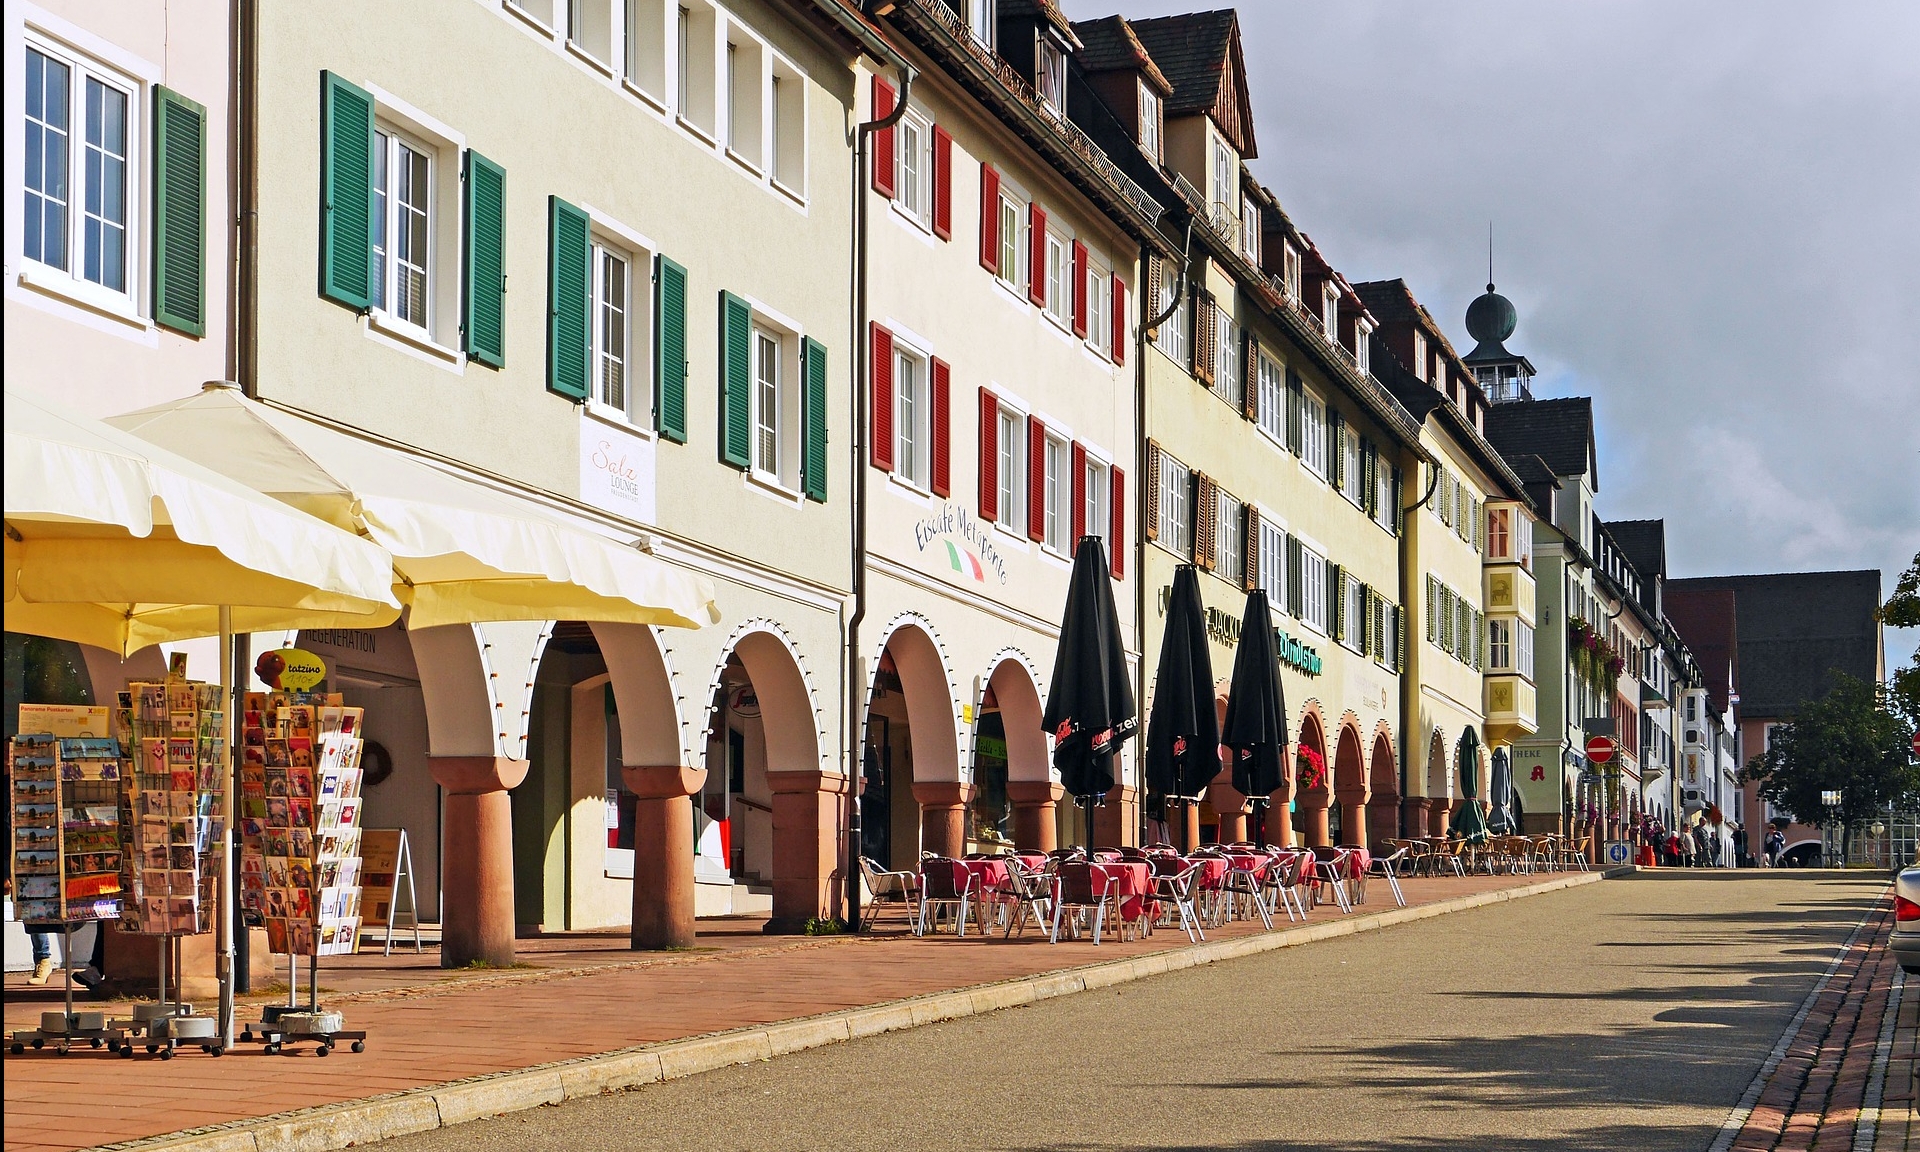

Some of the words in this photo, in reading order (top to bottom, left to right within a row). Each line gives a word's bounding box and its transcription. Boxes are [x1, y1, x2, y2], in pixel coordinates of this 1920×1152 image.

[592, 440, 637, 481] Salz
[610, 475, 639, 496] LOUNGE
[915, 502, 953, 552] Eiscafé
[957, 505, 1007, 586] Metaponto
[305, 628, 376, 654] REGENERATION
[288, 663, 321, 674] tatzino
[1116, 714, 1139, 734] zer
[1513, 749, 1542, 758] THEKE
